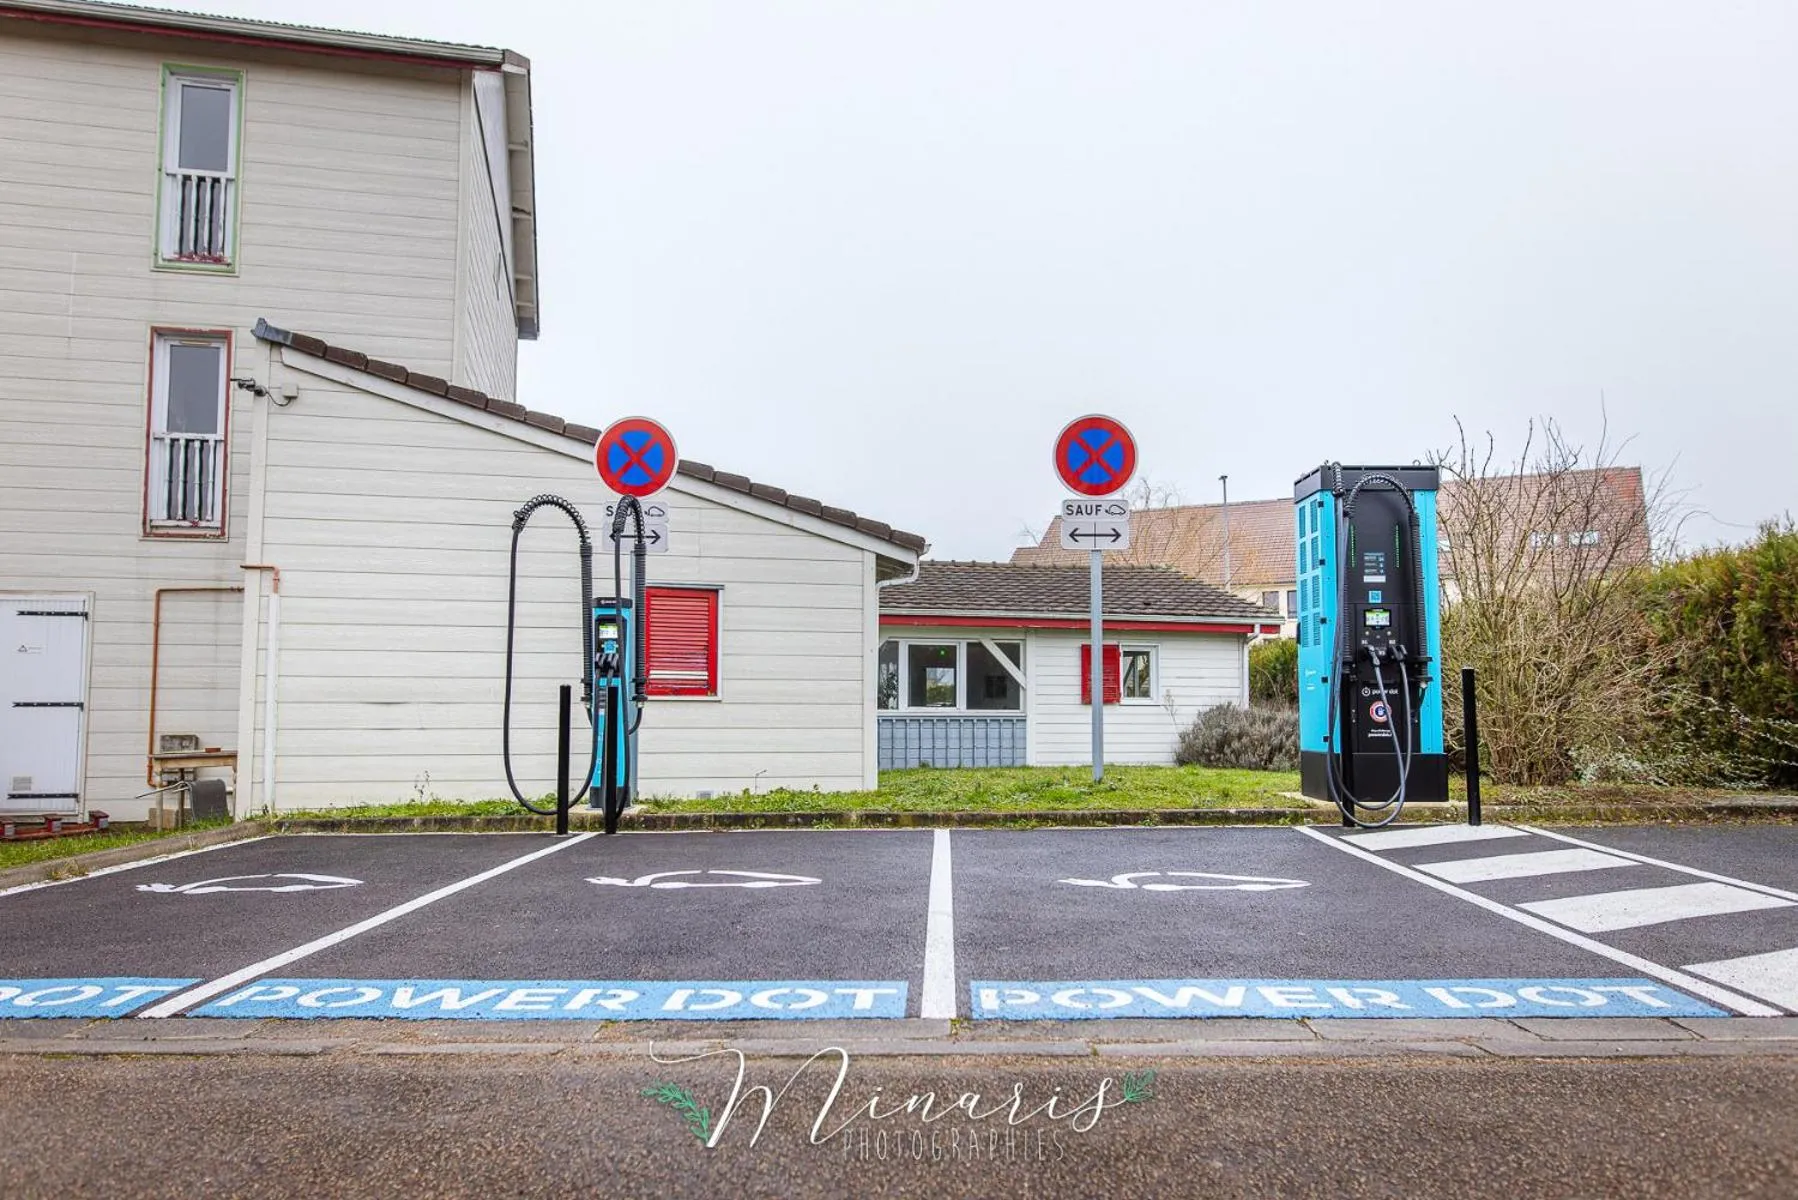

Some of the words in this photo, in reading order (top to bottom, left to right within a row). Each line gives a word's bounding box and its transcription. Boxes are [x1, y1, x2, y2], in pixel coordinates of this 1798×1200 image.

[1065, 504, 1102, 516] SAUF
[215, 985, 639, 1010] POWER
[662, 986, 898, 1011] DOT
[978, 986, 1413, 1010] POWER
[1422, 986, 1672, 1008] DOT
